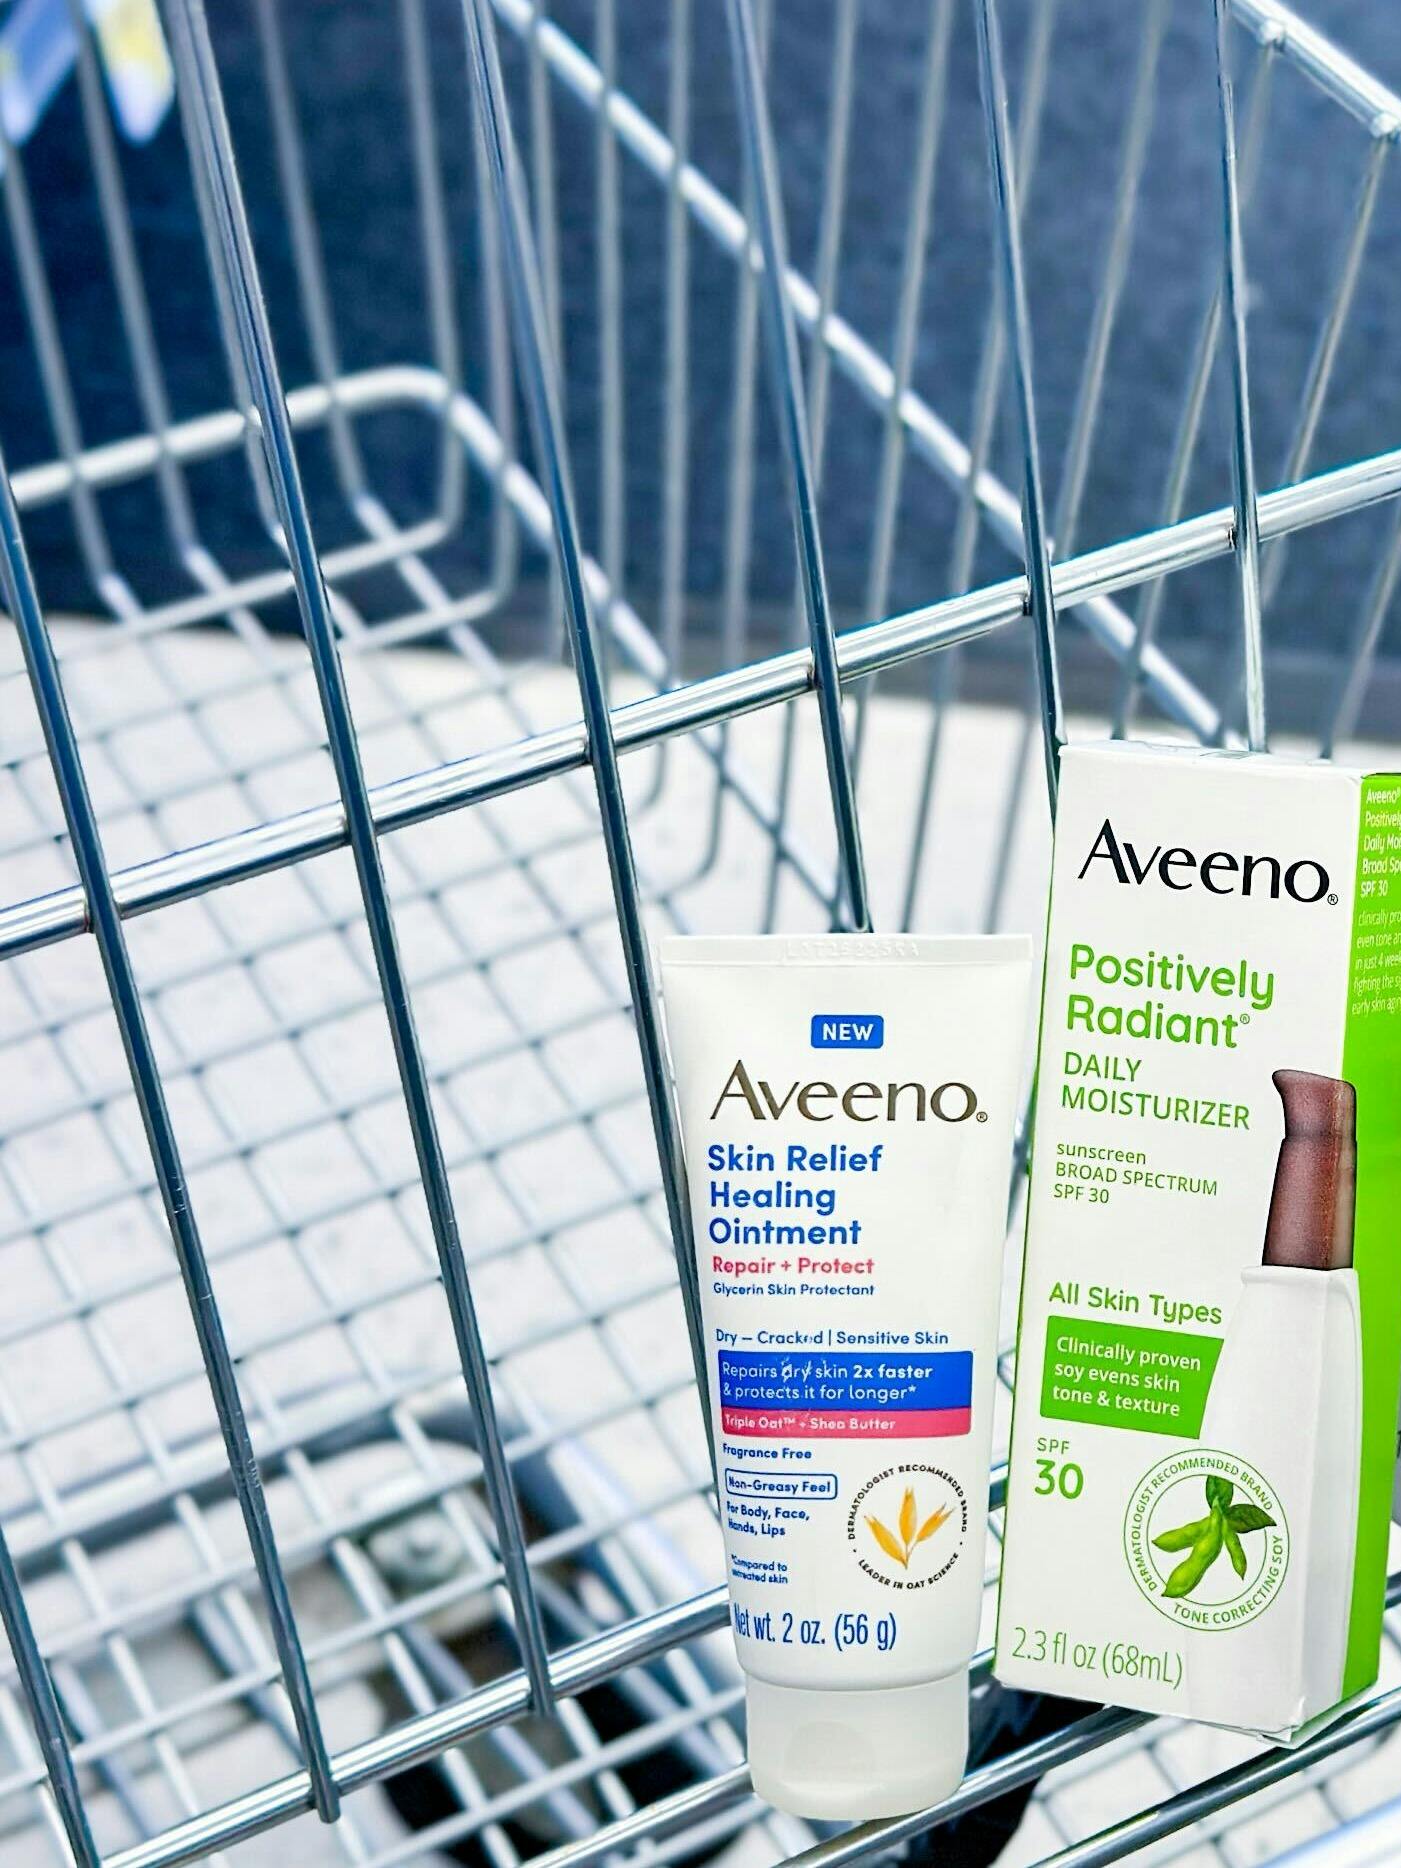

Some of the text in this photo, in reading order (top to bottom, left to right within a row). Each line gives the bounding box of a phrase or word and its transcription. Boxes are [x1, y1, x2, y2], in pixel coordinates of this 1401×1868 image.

[1363, 832, 1385, 855] Daily
[1078, 818, 1339, 906] Aveeno®
[1362, 856, 1387, 875] Broad
[1360, 879, 1389, 898] SPF 30
[1358, 908, 1389, 929] clinically
[1356, 934, 1375, 949] even
[1363, 954, 1377, 975] just
[1069, 943, 1275, 1011] Positively
[1382, 974, 1393, 990] the
[822, 1023, 874, 1041] NEW
[1067, 994, 1250, 1049] Radiant®
[1063, 1051, 1142, 1083] DAILY
[710, 1059, 988, 1123] Aveeno®
[1062, 1084, 1250, 1130] MOISTURIZER
[707, 1143, 884, 1172] Skin Relief
[1056, 1143, 1147, 1166] sunscreen
[1056, 1162, 1218, 1197] BROAD SPECTRUM
[711, 1181, 836, 1216] Healing
[1053, 1183, 1110, 1205] SPF 30
[709, 1218, 862, 1245] Ointment
[712, 1256, 776, 1278] Repair
[798, 1257, 875, 1274] Protect
[713, 1283, 875, 1298] Glycerin Skin Protectant
[1048, 1281, 1223, 1325] All Skin Types
[716, 1328, 737, 1347] Dry
[837, 1331, 910, 1345] Sensitive
[915, 1331, 949, 1345] Skin
[1056, 1336, 1201, 1376] Clinically proven
[722, 1361, 778, 1381] Repairs
[815, 1360, 848, 1379] skin
[853, 1365, 873, 1379] 2x
[878, 1364, 933, 1379] faster
[1054, 1363, 1180, 1393] soy evens skin
[723, 1382, 732, 1396] &
[735, 1386, 800, 1401] protects
[804, 1385, 816, 1399] it
[820, 1384, 844, 1399] for
[1053, 1385, 1180, 1418] tone & texture
[725, 1413, 756, 1430] Triple
[809, 1417, 846, 1430] Shea
[849, 1418, 896, 1431] Butter
[722, 1443, 812, 1460] Fragrance Free
[1036, 1437, 1070, 1456] SPF
[728, 1476, 831, 1496] Non-Greasy Feel
[1033, 1458, 1085, 1500] 30
[726, 1500, 810, 1521] For Body, Face,
[847, 1464, 968, 1541] DERMATOLOGIST RECOMMENDED BRAND
[727, 1517, 786, 1538] Hands, Lips
[1131, 1457, 1273, 1592] DERMATOLOGIST RECOMMENDED BRAND
[777, 1560, 788, 1572] to
[858, 1552, 959, 1590] LEADER IN OAT SCIENCE
[768, 1573, 789, 1585] skin
[1174, 1535, 1284, 1624] TONE CORRECTING SOY
[733, 1602, 897, 1652] Net wt. 2 oz. (56 g)
[1011, 1626, 1183, 1690] 2.3 fl oz (68mL)
